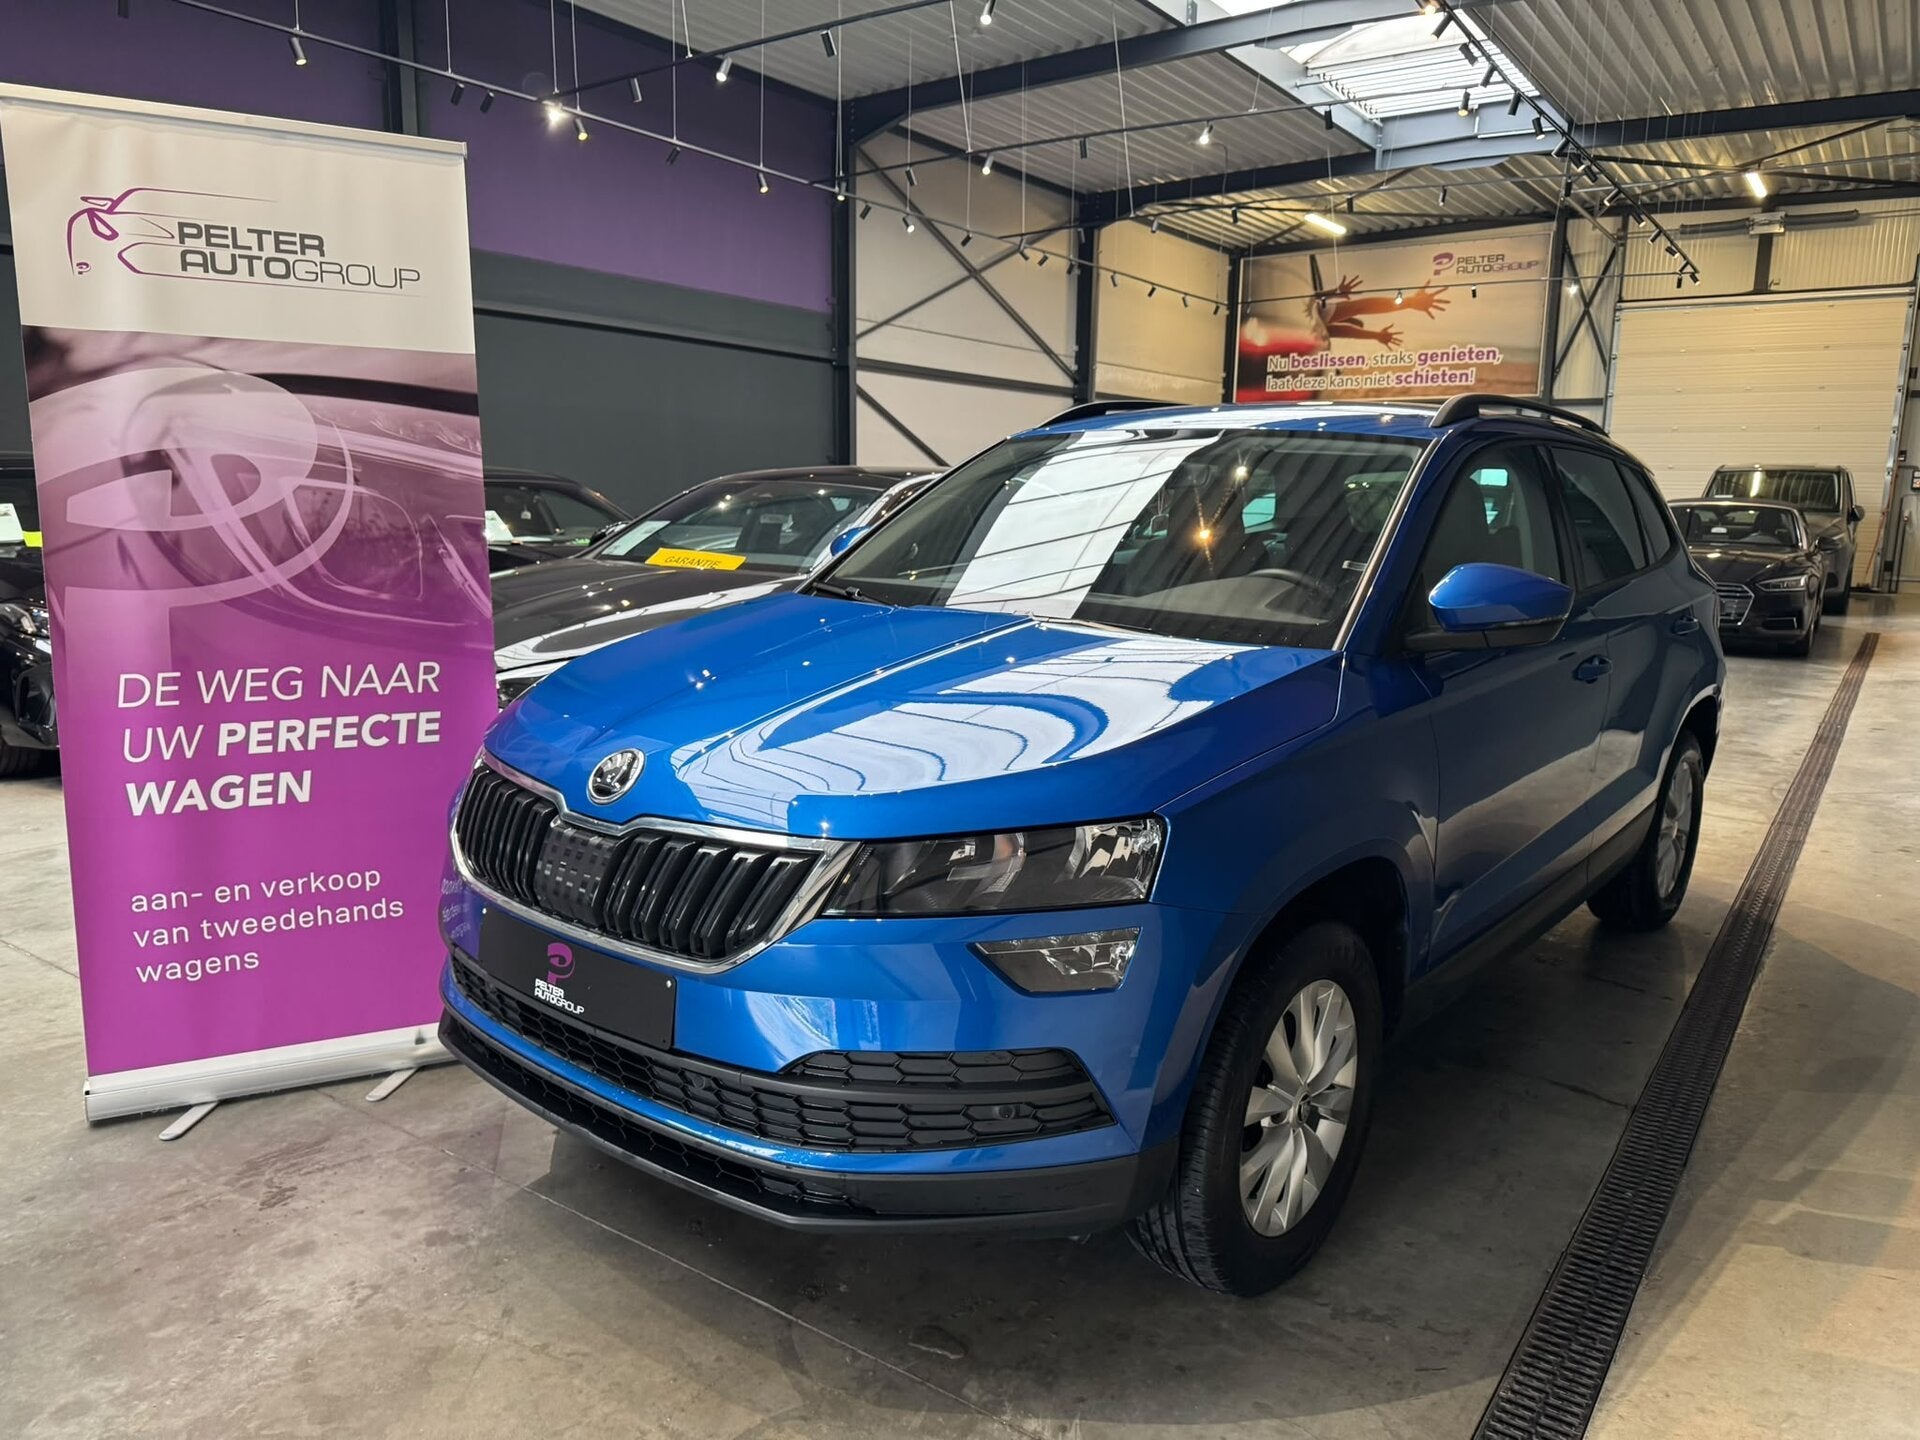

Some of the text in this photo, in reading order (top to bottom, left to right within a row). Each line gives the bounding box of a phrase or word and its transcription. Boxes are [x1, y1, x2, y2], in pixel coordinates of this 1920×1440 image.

[177, 220, 326, 258] PELTER
[180, 248, 421, 290] AUTOGROUP
[1456, 261, 1540, 274] AUTOGROUP
[1457, 253, 1505, 265] PELTER
[1267, 346, 1502, 371] Nu beslissen, straks genieten,
[1267, 367, 1475, 390] laat deze kans niet schieten!
[664, 556, 721, 569] GARANTIE
[117, 661, 441, 709] DE WEG NAAR
[122, 711, 442, 763] UW PERFECTE
[125, 769, 313, 817] WAGEN
[131, 869, 381, 913] aan- en verkoop
[133, 926, 190, 948] van
[199, 898, 405, 941] tweedehands
[136, 951, 260, 984] wagens
[534, 987, 585, 1014] AUTOGROUP
[535, 978, 565, 998] PELTER
